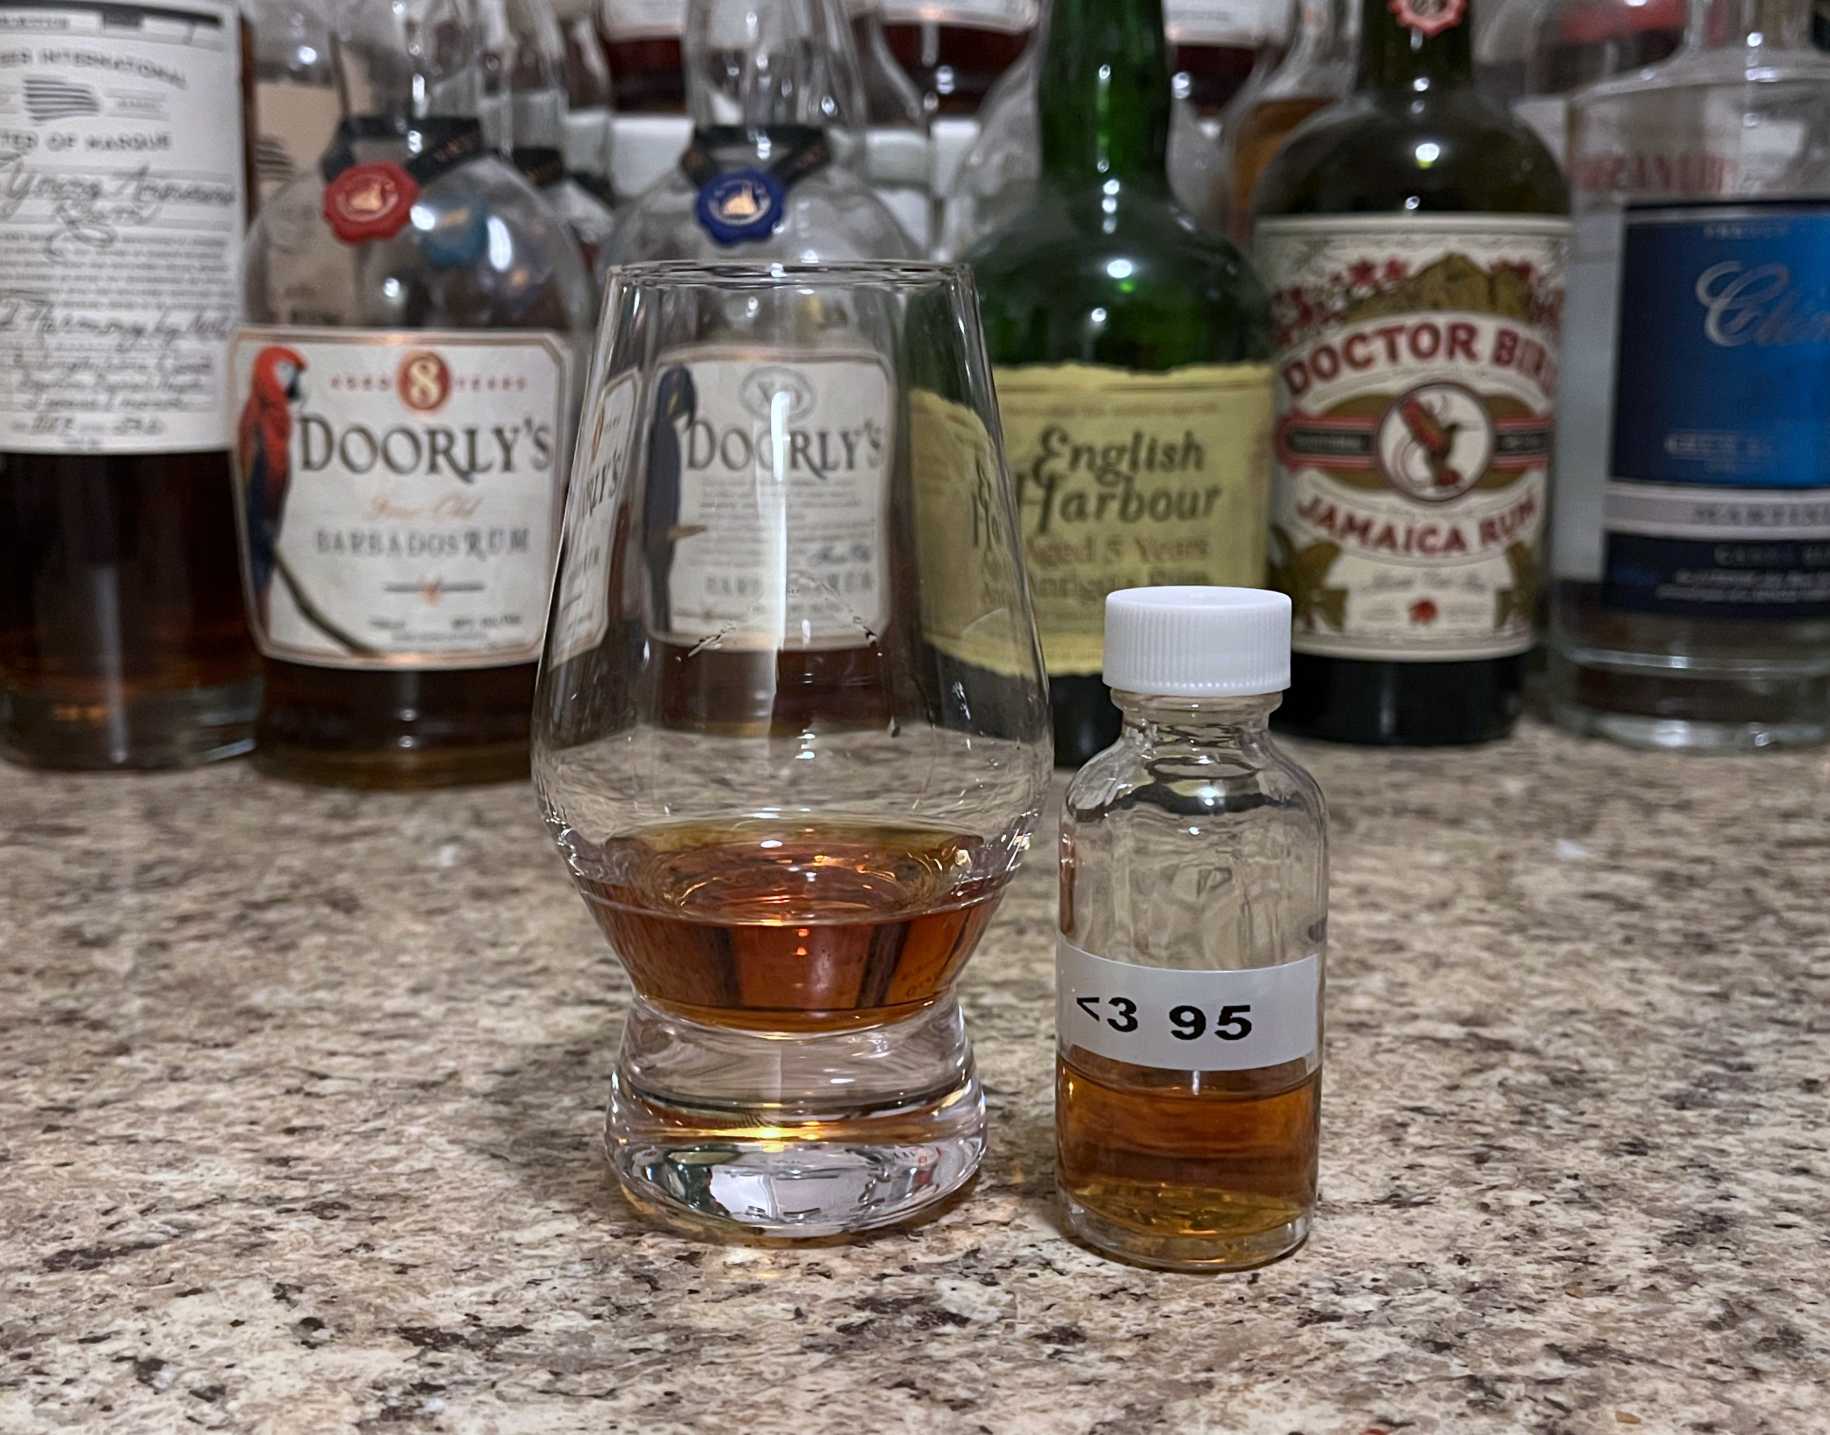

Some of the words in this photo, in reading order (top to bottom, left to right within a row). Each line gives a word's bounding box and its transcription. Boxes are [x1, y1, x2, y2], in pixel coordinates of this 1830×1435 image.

[409, 360, 441, 402] 8
[1281, 322, 1479, 397] DOCTOR
[298, 414, 552, 484] DOORLY'S
[1031, 424, 1206, 488] English
[1013, 470, 1223, 534] Harbour
[1296, 494, 1469, 555] JAMAICA
[1478, 498, 1538, 548] RUM
[316, 531, 461, 558] BARBADOS
[463, 526, 530, 562] RUM
[1075, 996, 1139, 1033] <3
[1169, 1004, 1253, 1041] 95
